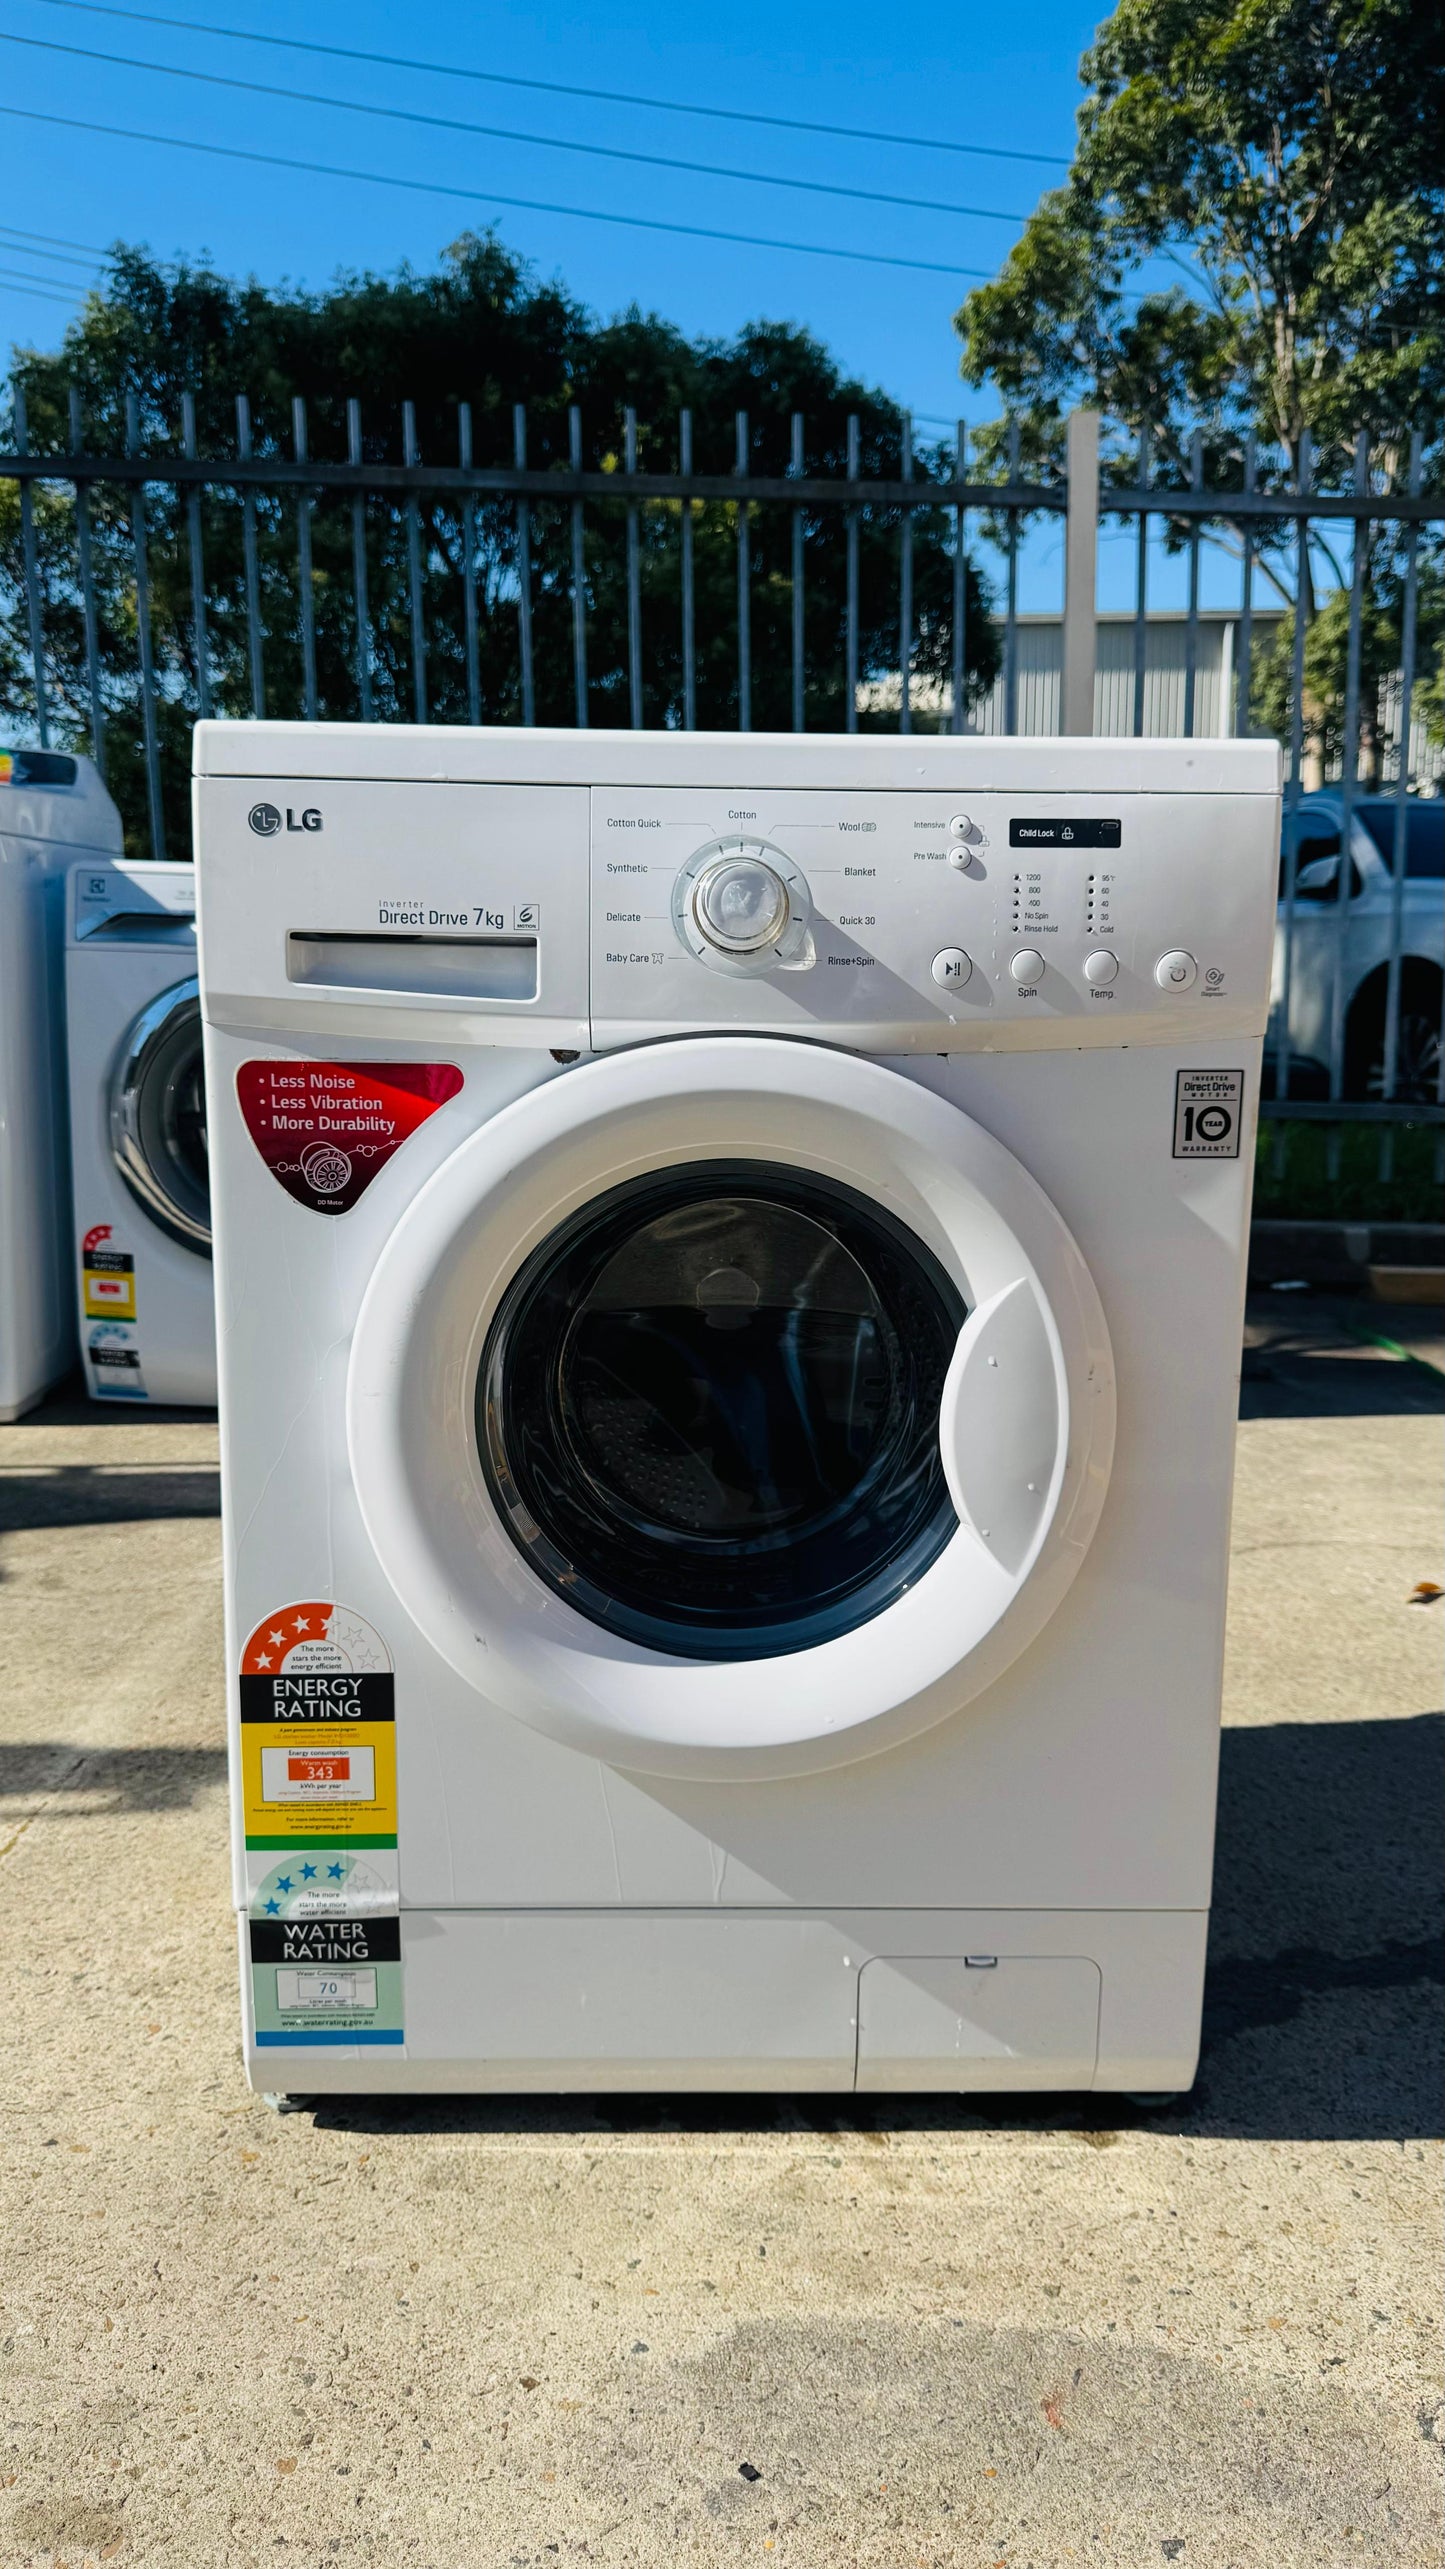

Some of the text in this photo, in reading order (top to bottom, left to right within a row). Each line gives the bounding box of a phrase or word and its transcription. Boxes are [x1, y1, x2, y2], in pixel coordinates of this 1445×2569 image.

[728, 809, 757, 819] Cotton
[286, 808, 323, 832] LG
[607, 818, 661, 829] Cotton Quick
[913, 821, 946, 829] Intensive
[838, 822, 861, 832] Wool
[1019, 829, 1055, 837] Child Lock
[913, 852, 947, 860] Pre Wash
[606, 863, 648, 873] Synthetic
[844, 867, 876, 877] Blanket
[1026, 873, 1041, 881] 1200
[1028, 886, 1041, 894] 800
[379, 900, 424, 909] Inverter
[379, 909, 425, 925] Direct
[429, 910, 468, 926] Drive
[606, 912, 641, 922] Delicate
[839, 916, 876, 926] Quick 30
[1034, 912, 1049, 921] Spin
[1100, 913, 1109, 921] 30
[1043, 925, 1058, 933] Hold
[606, 953, 650, 964] Baby Care
[827, 956, 875, 967] Rinse+Spin
[1017, 987, 1037, 998] Spin
[270, 1073, 355, 1089] Less Noise
[1184, 1082, 1235, 1091] Direct Drive
[271, 1094, 383, 1110] Less Vibration
[272, 1115, 395, 1135] More Durability
[1184, 1105, 1231, 1142] 10
[273, 1678, 363, 1697] ENERGY
[274, 1699, 361, 1718] RATING
[307, 1766, 334, 1780] 343
[284, 1923, 366, 1941] WATER
[283, 1941, 369, 1960] RATING
[319, 1982, 338, 1994] 70
